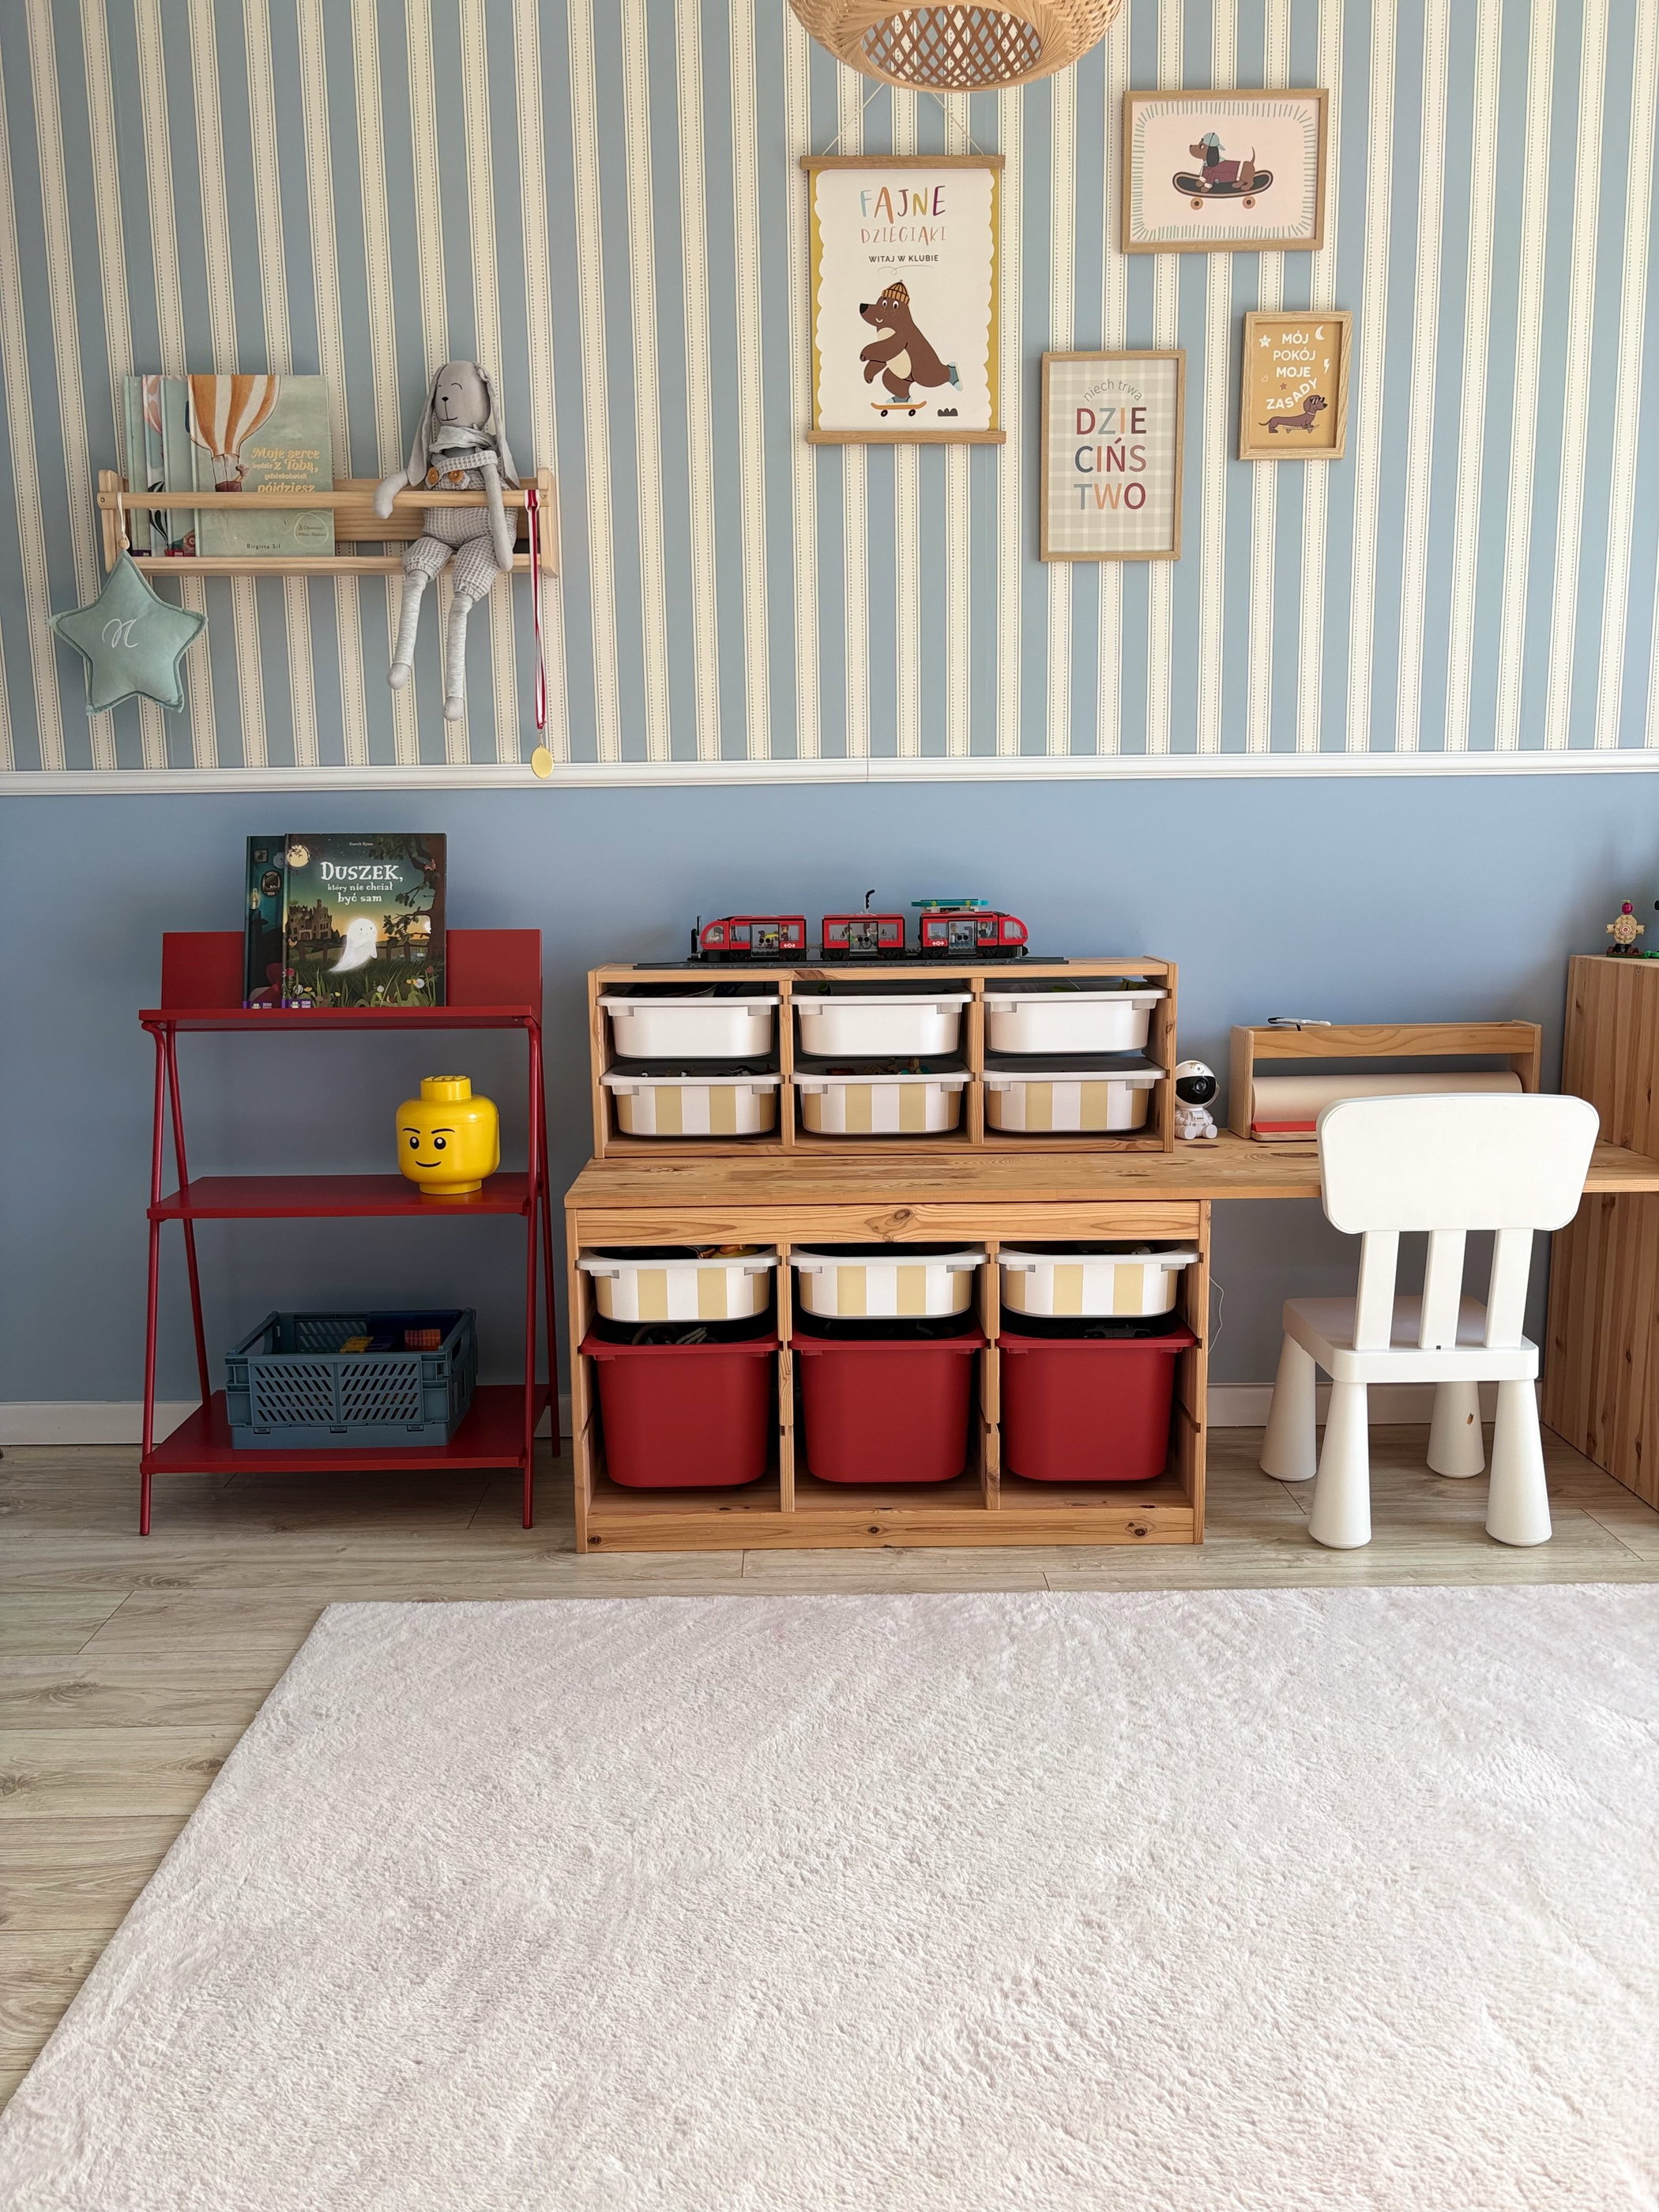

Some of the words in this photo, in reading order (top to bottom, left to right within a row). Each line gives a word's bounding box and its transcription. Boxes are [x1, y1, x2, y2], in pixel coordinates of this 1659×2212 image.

[860, 185, 946, 224] FAJNE
[861, 226, 946, 246] DZIECIAKI
[1281, 330, 1309, 344] MÓJ
[1273, 347, 1316, 361] POKÓJ
[1276, 367, 1311, 378] MOJE
[1083, 378, 1115, 402] niech
[1118, 379, 1142, 401] trwa
[1266, 378, 1318, 410] ZASADY
[1076, 407, 1147, 434] DZIE
[250, 447, 284, 461] Moje
[288, 449, 320, 459] serce
[1074, 437, 1146, 472] CIŃS
[1074, 483, 1146, 510] TWO
[327, 883, 348, 892] który
[366, 881, 393, 891] chciał
[337, 892, 358, 905] być
